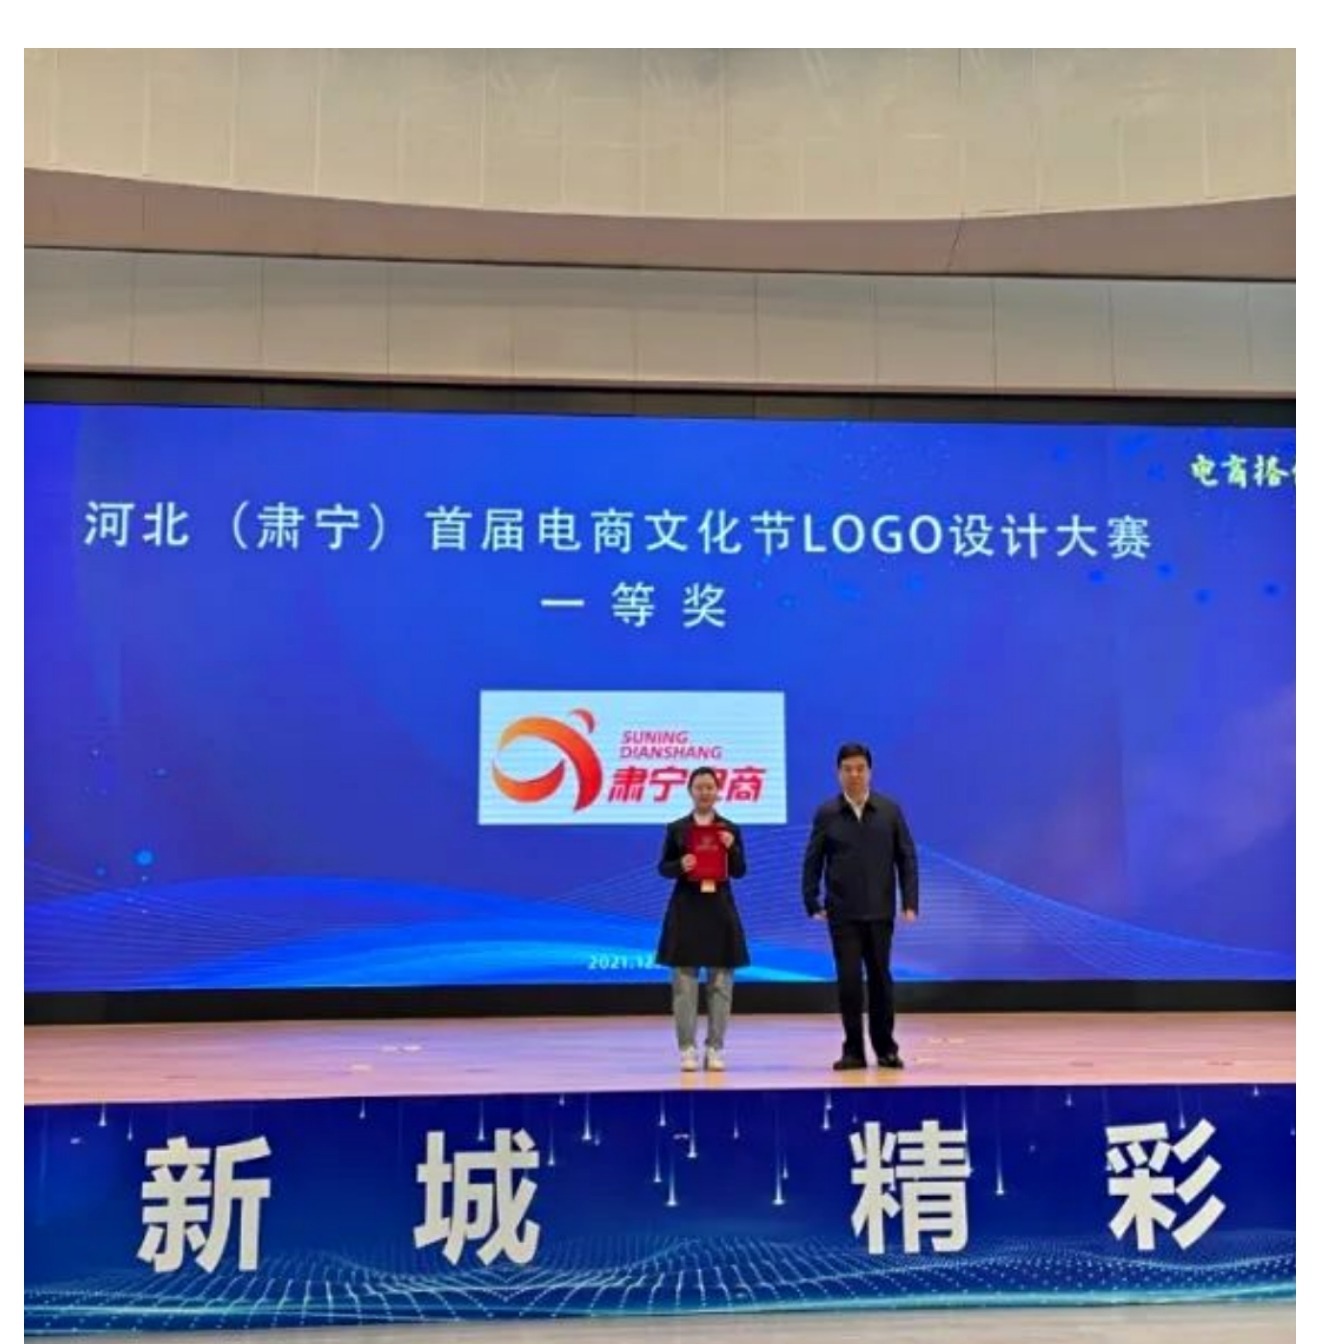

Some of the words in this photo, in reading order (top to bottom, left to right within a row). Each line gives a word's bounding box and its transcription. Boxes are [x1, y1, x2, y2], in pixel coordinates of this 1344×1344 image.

[540, 581, 726, 628] 一等奖
[622, 730, 690, 744] SUNING
[619, 746, 723, 759] DIANSHANG
[136, 1129, 540, 1273] 新城
[849, 1118, 1228, 1256] 精彩
